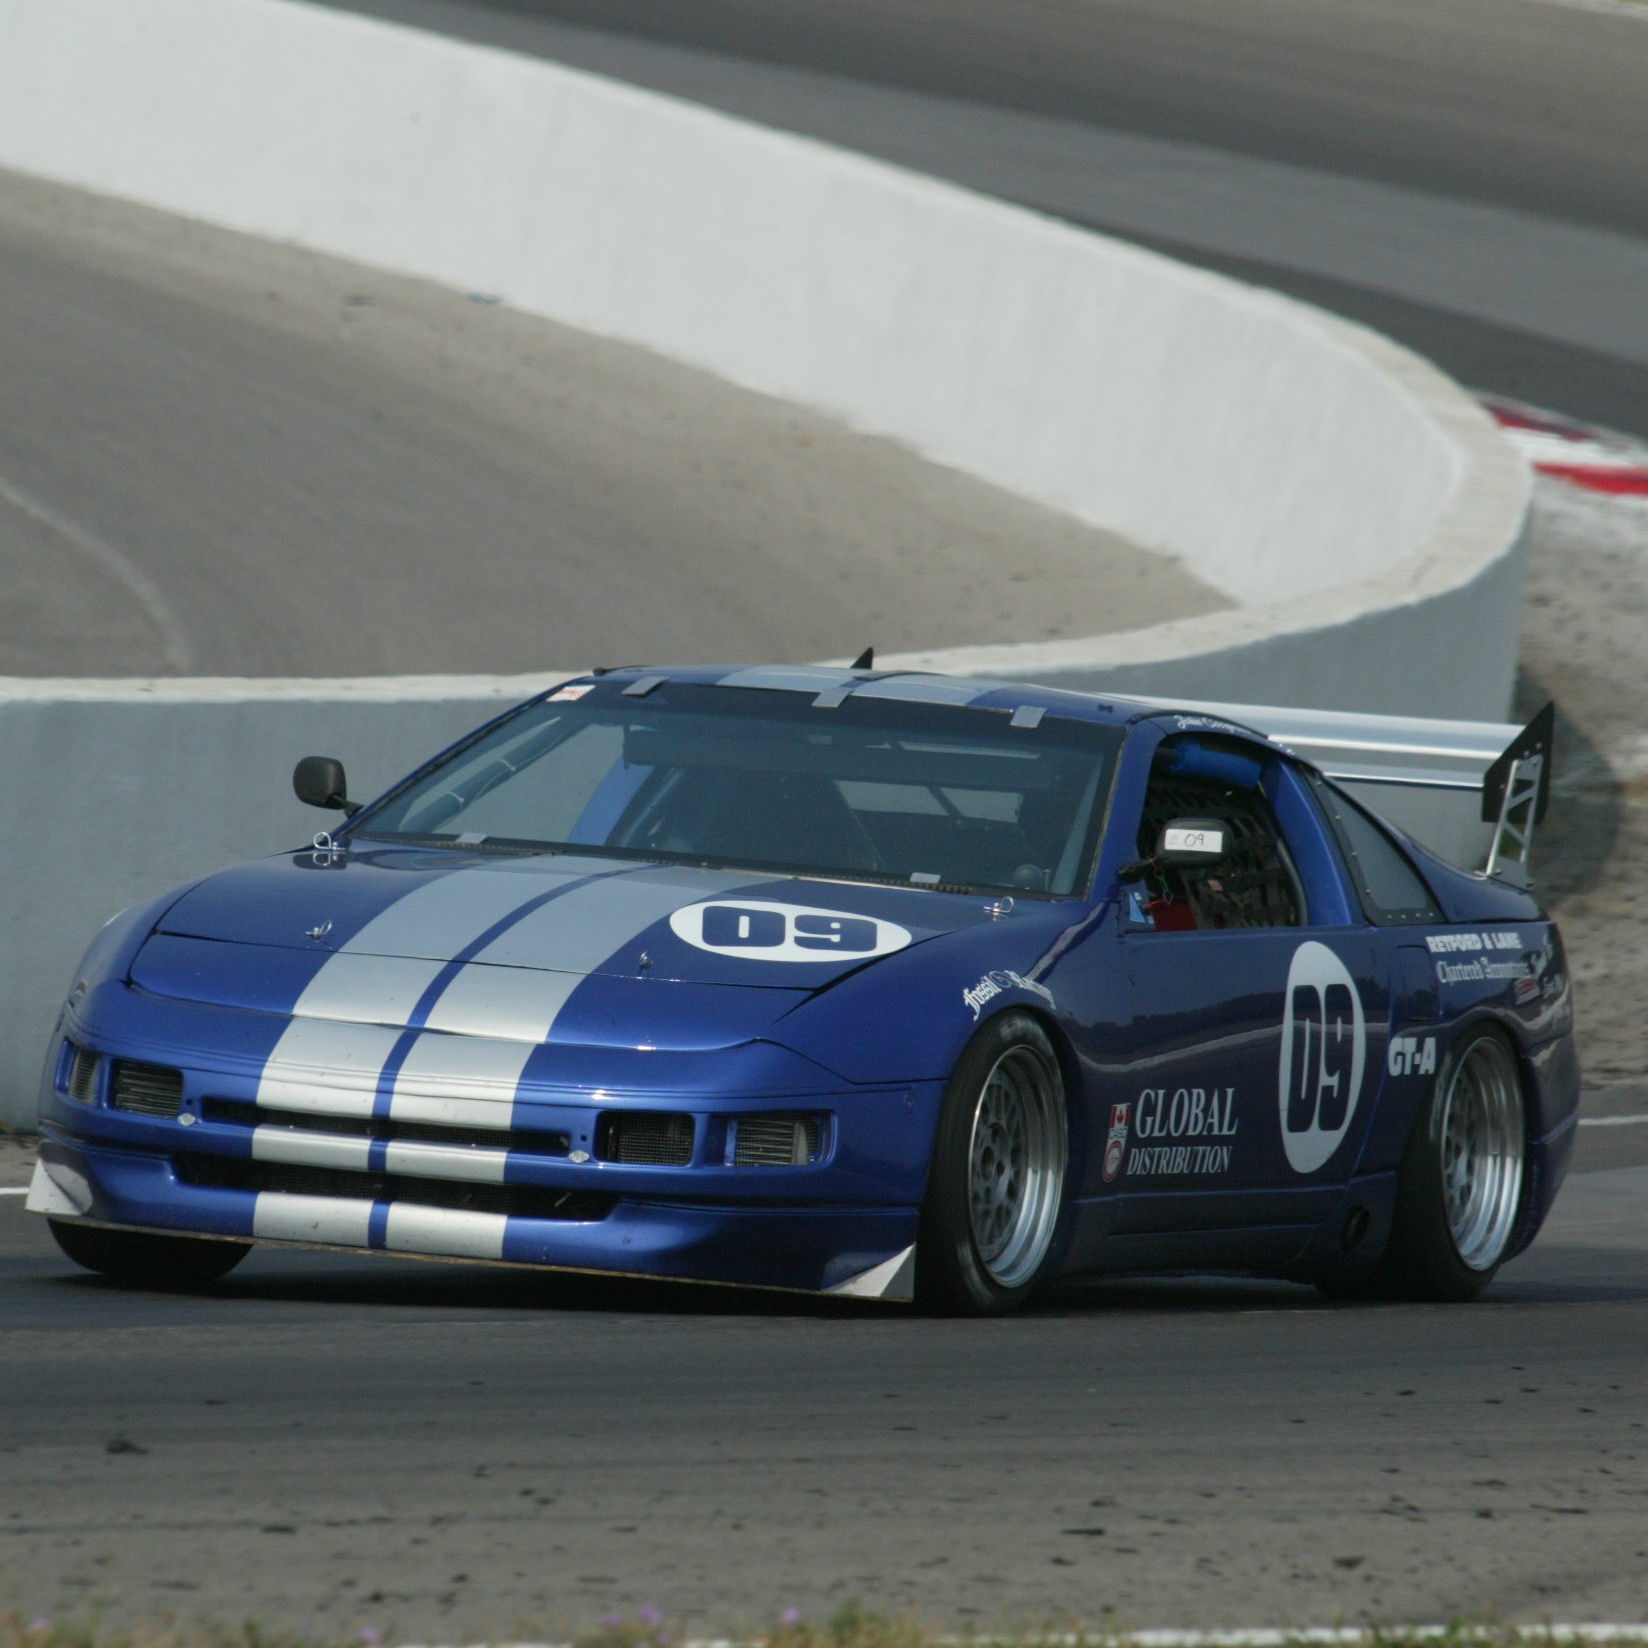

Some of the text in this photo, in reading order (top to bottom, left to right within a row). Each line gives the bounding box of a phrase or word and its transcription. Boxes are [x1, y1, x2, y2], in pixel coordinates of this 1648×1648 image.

[1184, 833, 1204, 847] 09
[702, 905, 877, 952] 09
[1286, 983, 1354, 1132] 09
[1388, 1037, 1436, 1076] GT-A
[1134, 1088, 1238, 1138] GLOBAL
[1126, 1146, 1232, 1176] DISTRIBUTION
